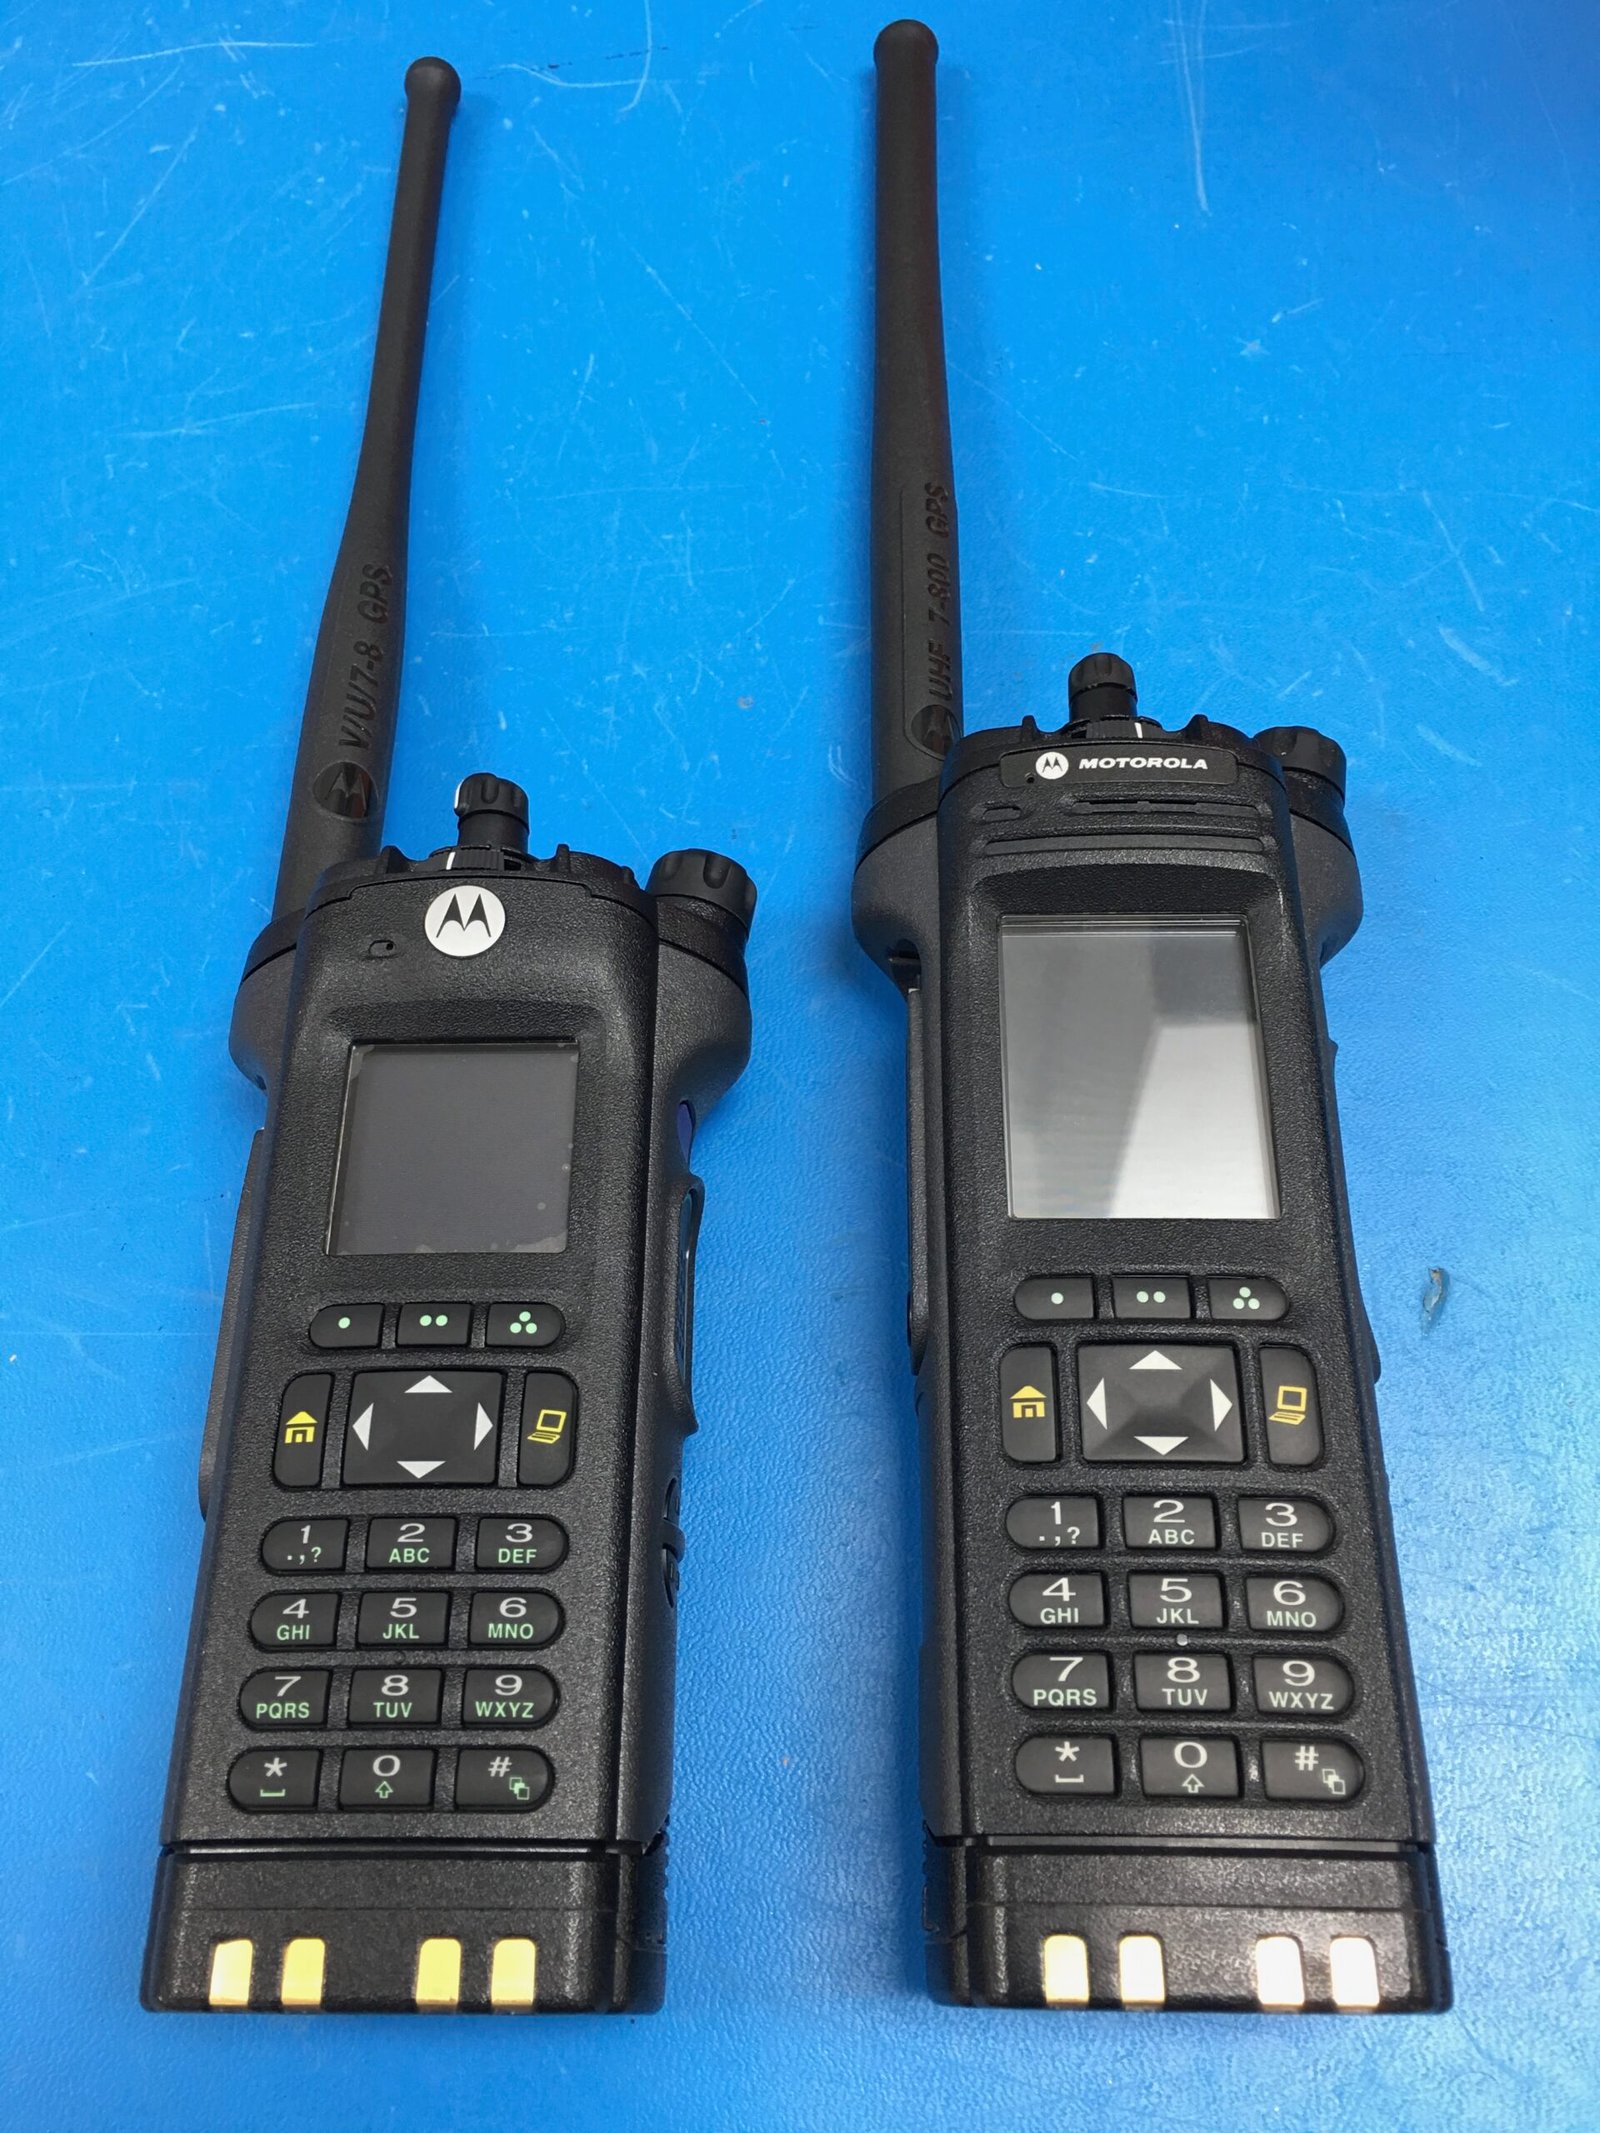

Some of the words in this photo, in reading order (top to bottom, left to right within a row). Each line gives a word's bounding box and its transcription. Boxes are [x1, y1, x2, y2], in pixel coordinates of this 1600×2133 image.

[924, 481, 950, 539] GPS
[356, 562, 393, 625] GPS
[926, 552, 951, 627] 7-800
[928, 638, 953, 701] UHF
[1078, 756, 1209, 771] MOTOROLA
[1050, 1501, 1062, 1525] 1
[1153, 1499, 1186, 1524] 2
[1265, 1502, 1298, 1527] 3
[300, 1524, 311, 1544] 1
[397, 1522, 426, 1543] 2
[505, 1522, 533, 1543] 3
[1147, 1528, 1195, 1546] ABC
[1260, 1531, 1304, 1549] DEF
[388, 1547, 430, 1564] ABC
[498, 1547, 538, 1564] DEF
[1041, 1577, 1077, 1602] 4
[1159, 1577, 1193, 1603] 5
[1272, 1580, 1307, 1606] 6
[282, 1598, 310, 1619] 4
[389, 1597, 418, 1619] 5
[499, 1596, 527, 1618] 6
[1039, 1607, 1079, 1625] GHI
[1155, 1607, 1200, 1625] JKL
[1266, 1609, 1317, 1629] MNO
[276, 1624, 311, 1641] GHI
[382, 1623, 420, 1640] JKL
[487, 1622, 534, 1640] MNO
[1049, 1656, 1084, 1682] 7
[1166, 1656, 1201, 1684] 8
[1282, 1660, 1316, 1687] 9
[274, 1675, 302, 1697] 7
[381, 1674, 409, 1697] 8
[494, 1674, 523, 1696] 9
[1033, 1687, 1098, 1707] PQRS
[1161, 1687, 1208, 1707] TUV
[1268, 1690, 1335, 1710] WXYZ
[255, 1701, 310, 1720] PQRS
[372, 1701, 413, 1719] TUV
[475, 1700, 535, 1719] WXYZ
